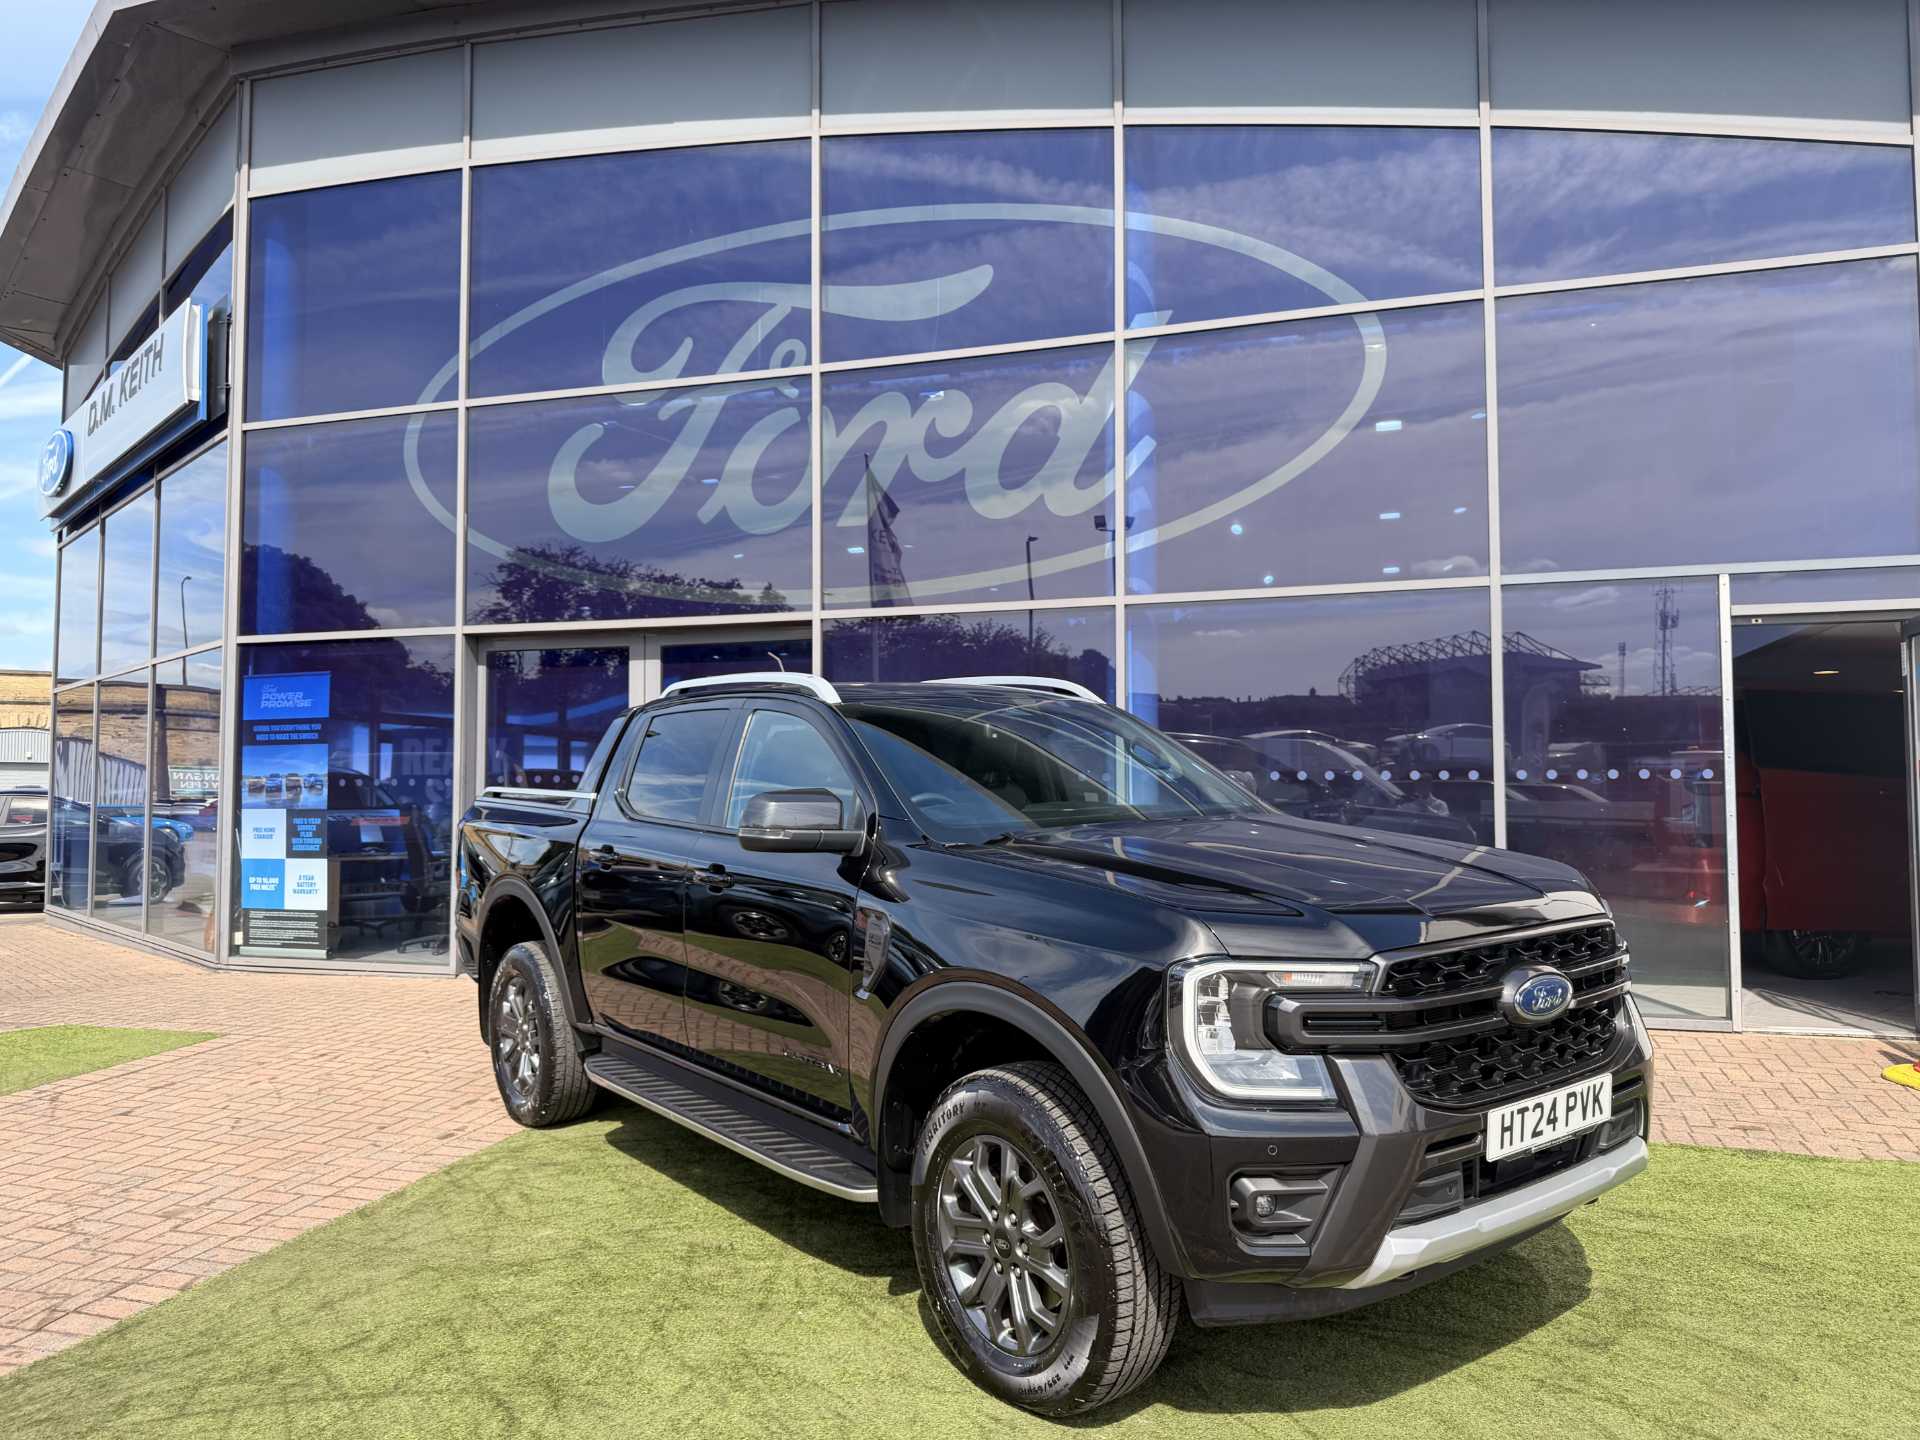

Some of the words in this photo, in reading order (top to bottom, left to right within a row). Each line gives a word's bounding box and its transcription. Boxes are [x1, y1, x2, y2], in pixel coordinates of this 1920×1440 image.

[88, 383, 115, 437] D.M.
[119, 333, 164, 408] KEITH
[548, 264, 1173, 542] Ford
[260, 698, 313, 709] PROMISE
[261, 691, 304, 701] POWER
[1531, 984, 1563, 1011] Ford
[1500, 1096, 1559, 1150] HT24
[1564, 1081, 1605, 1128] PVK
